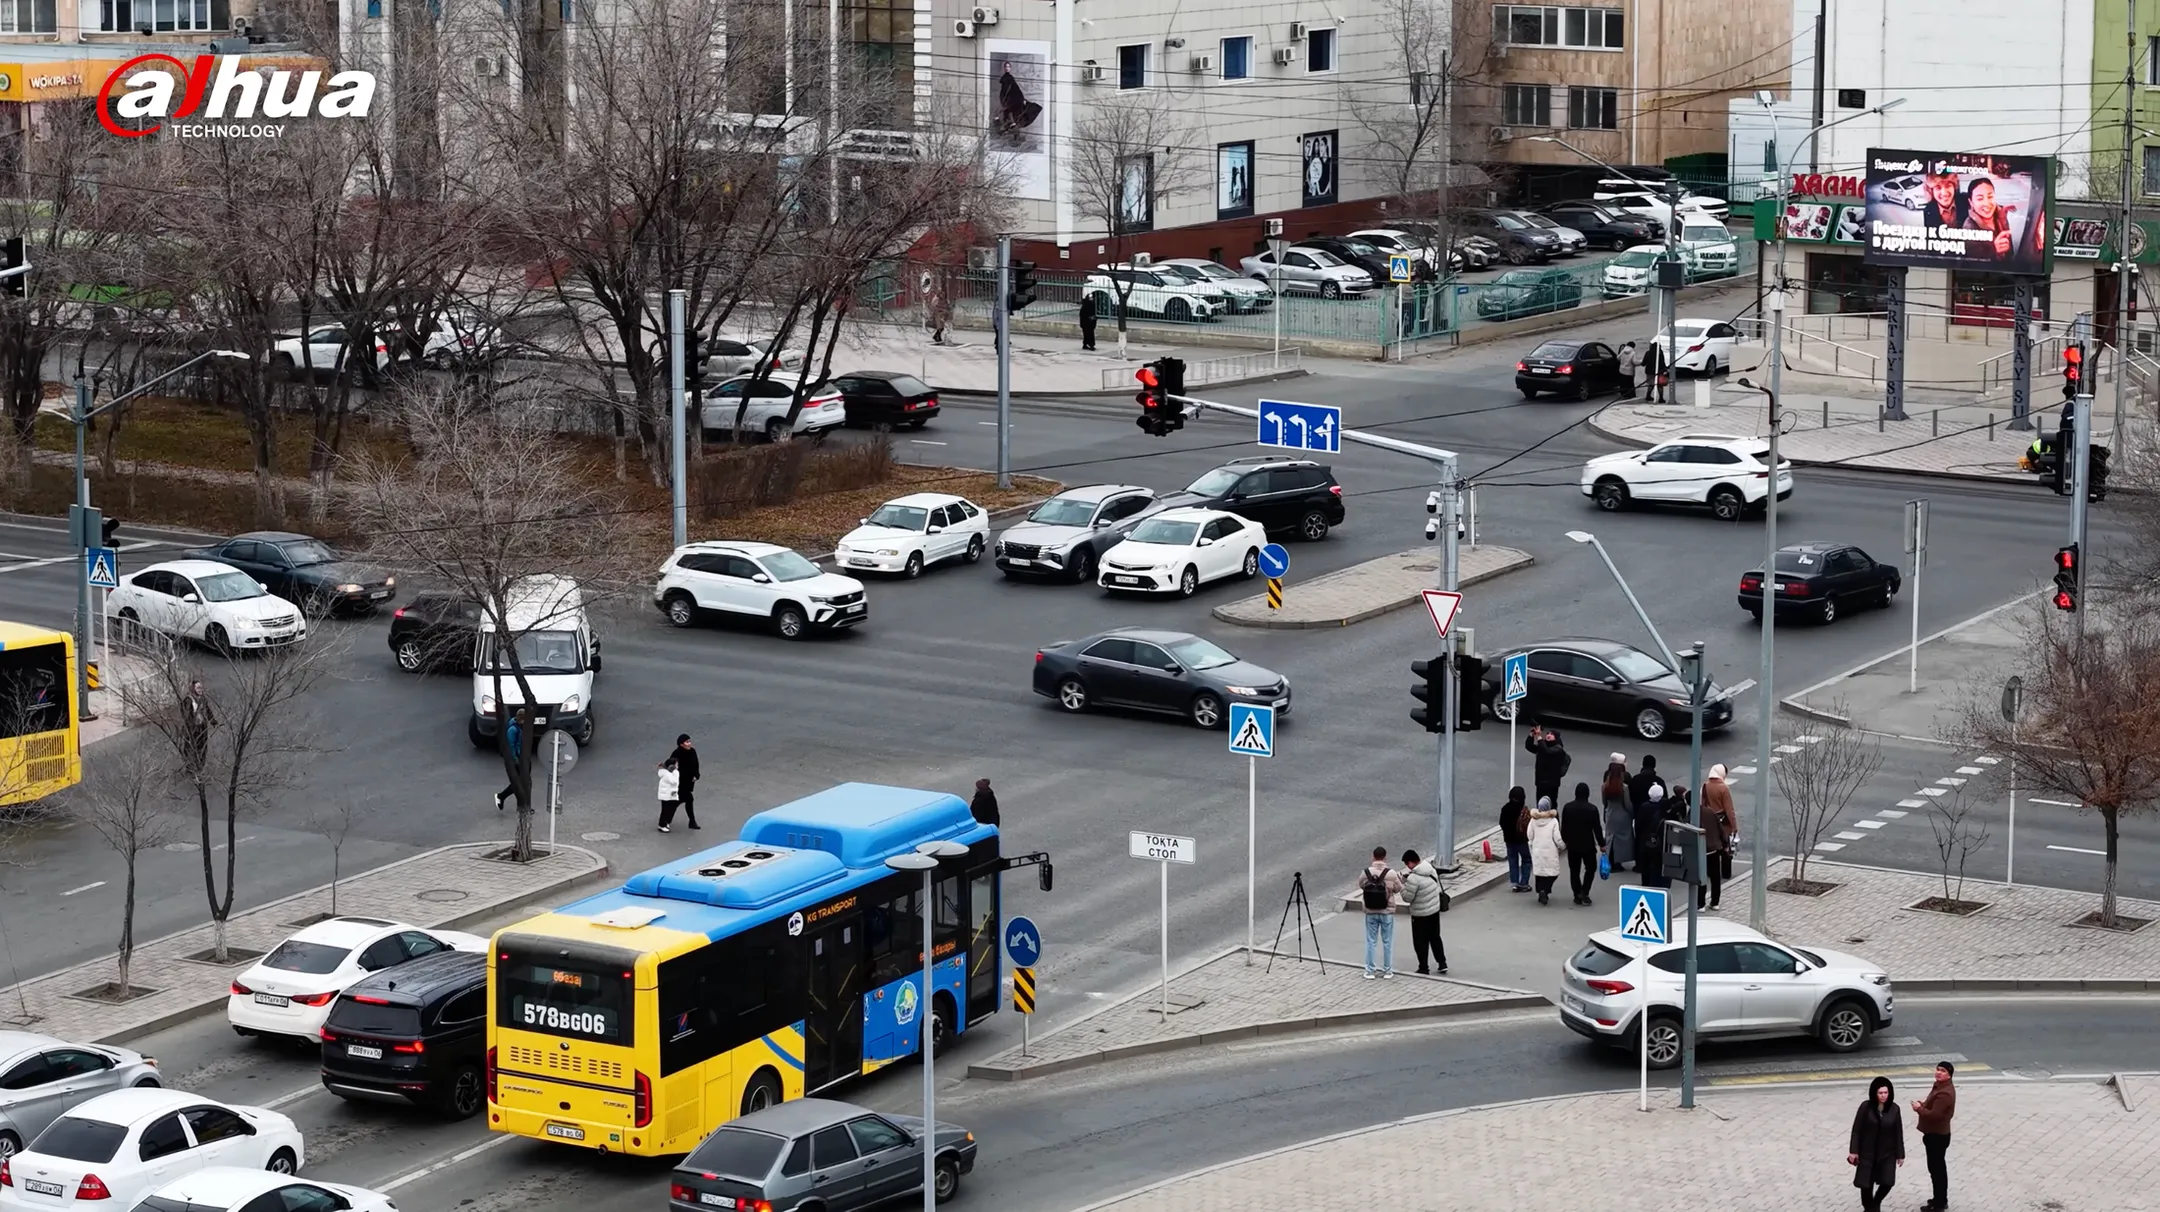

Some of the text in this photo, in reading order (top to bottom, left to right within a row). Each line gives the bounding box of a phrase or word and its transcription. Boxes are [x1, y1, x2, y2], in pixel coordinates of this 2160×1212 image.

[1873, 220, 1927, 239] Поездки
[1928, 240, 1966, 254] город
[1886, 276, 1898, 410] SARTAY SU
[2014, 286, 2026, 381] SARTAY
[1148, 848, 1177, 859] СТОП
[807, 896, 857, 923] KG TRANSPORT
[524, 1003, 605, 1035] 578BG06
